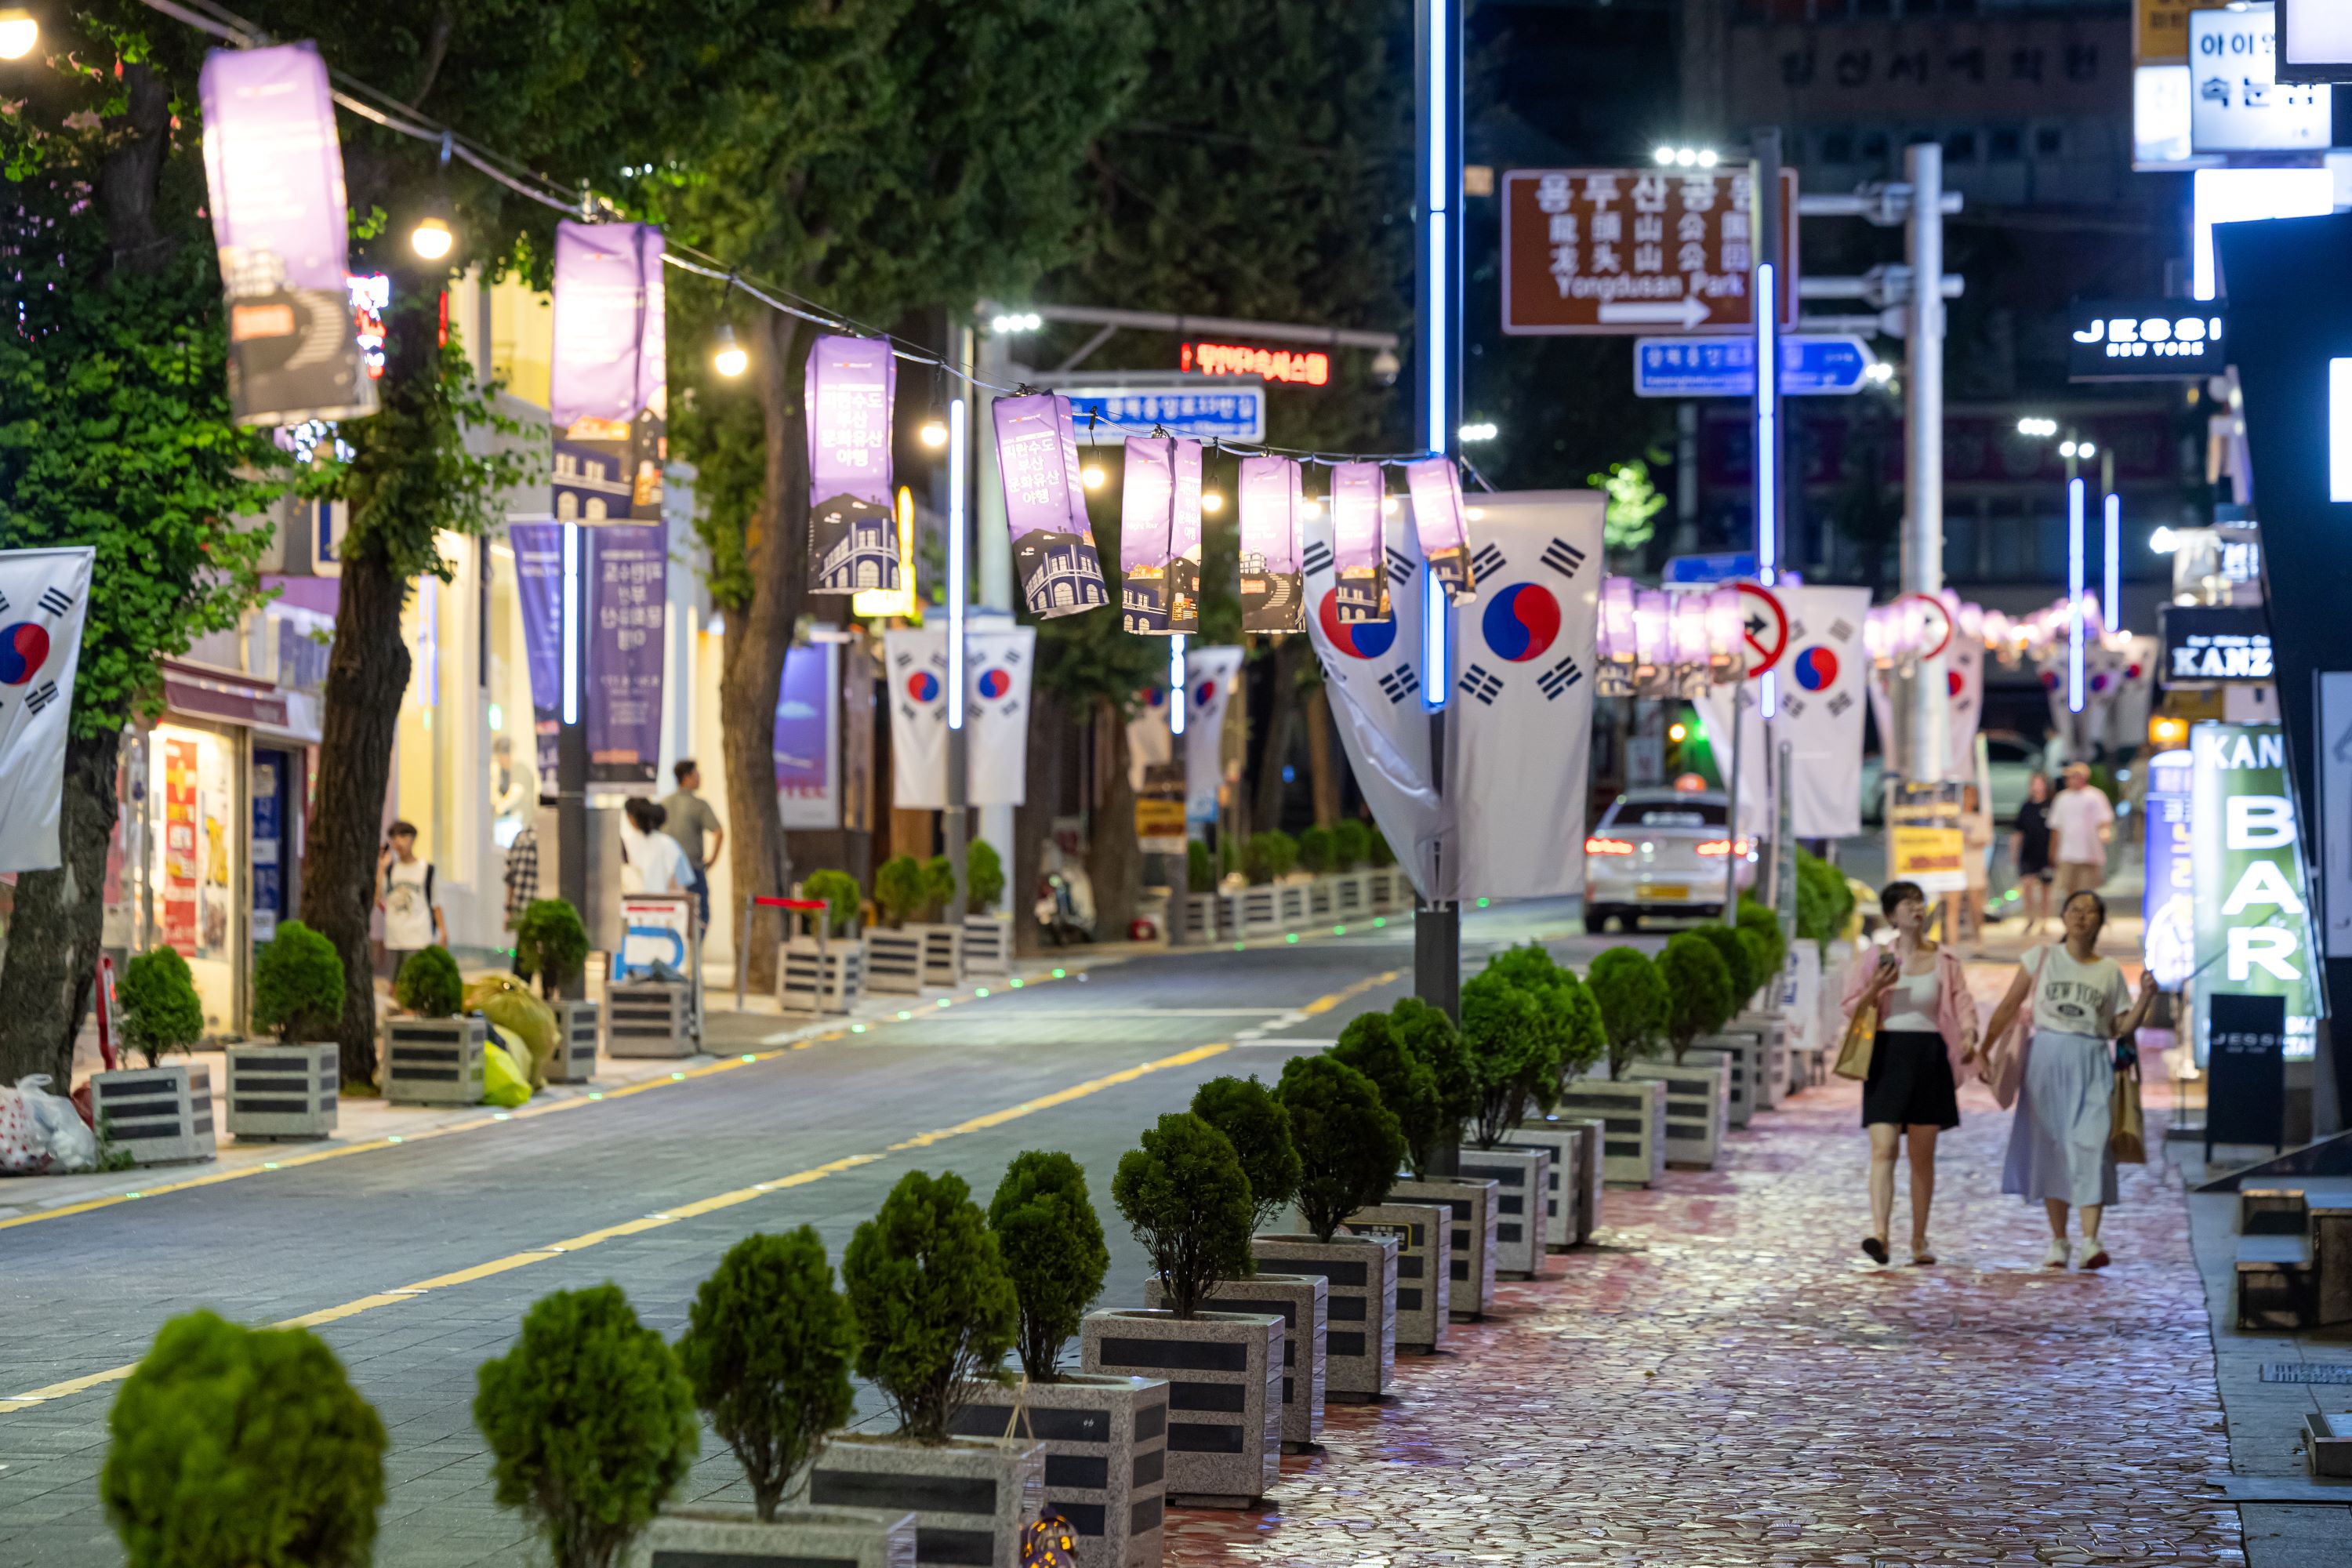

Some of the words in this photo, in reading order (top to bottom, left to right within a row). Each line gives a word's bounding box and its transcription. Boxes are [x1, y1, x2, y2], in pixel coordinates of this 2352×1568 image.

[1555, 271, 1682, 302] Yongdusan
[1690, 270, 1744, 298] Park
[2072, 317, 2222, 343] JESSI
[2106, 342, 2147, 358] NEW
[2153, 341, 2205, 357] YORK
[1002, 438, 1056, 459] 피란수도
[1018, 456, 1044, 474] 부산
[1007, 470, 1060, 493] 문화유산
[1022, 488, 1050, 506] 야행
[2172, 647, 2274, 677] KANZ
[2220, 794, 2305, 981] BAR
